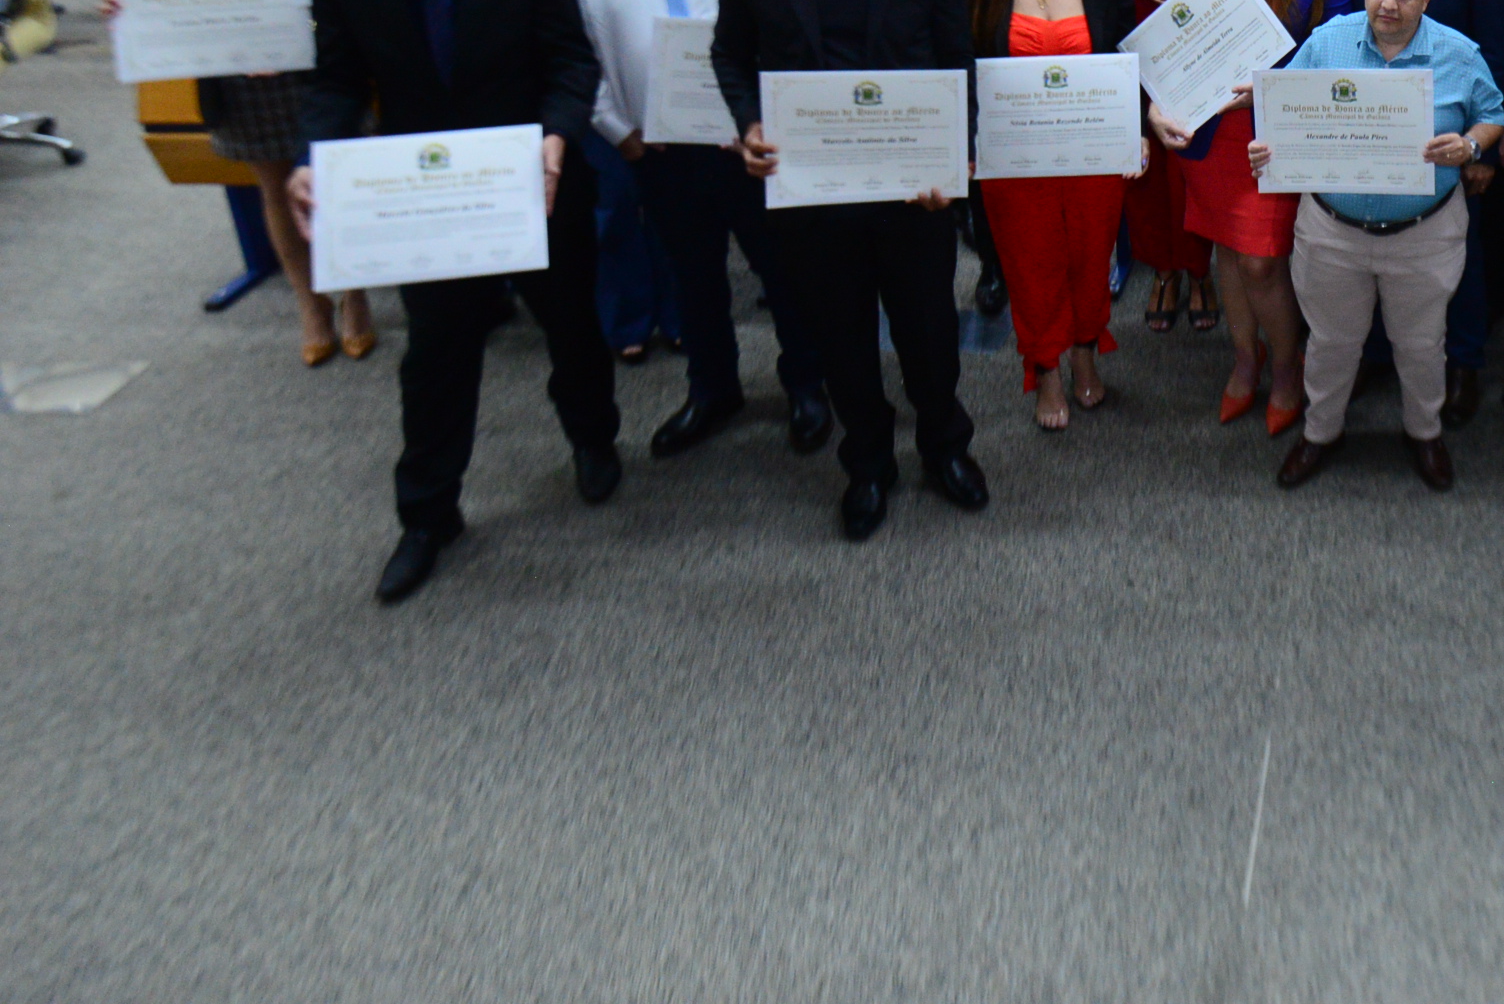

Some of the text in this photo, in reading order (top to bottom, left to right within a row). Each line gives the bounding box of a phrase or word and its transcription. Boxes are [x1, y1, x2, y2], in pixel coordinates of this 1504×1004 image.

[1151, 41, 1176, 64] Diploma
[1282, 104, 1319, 114] Diploma
[1321, 104, 1331, 113] de
[1365, 105, 1375, 113] ao
[1378, 104, 1409, 114] Mérito
[1304, 133, 1339, 141] Alexandre
[1349, 133, 1370, 141] Paula
[1371, 133, 1388, 141] Pires
